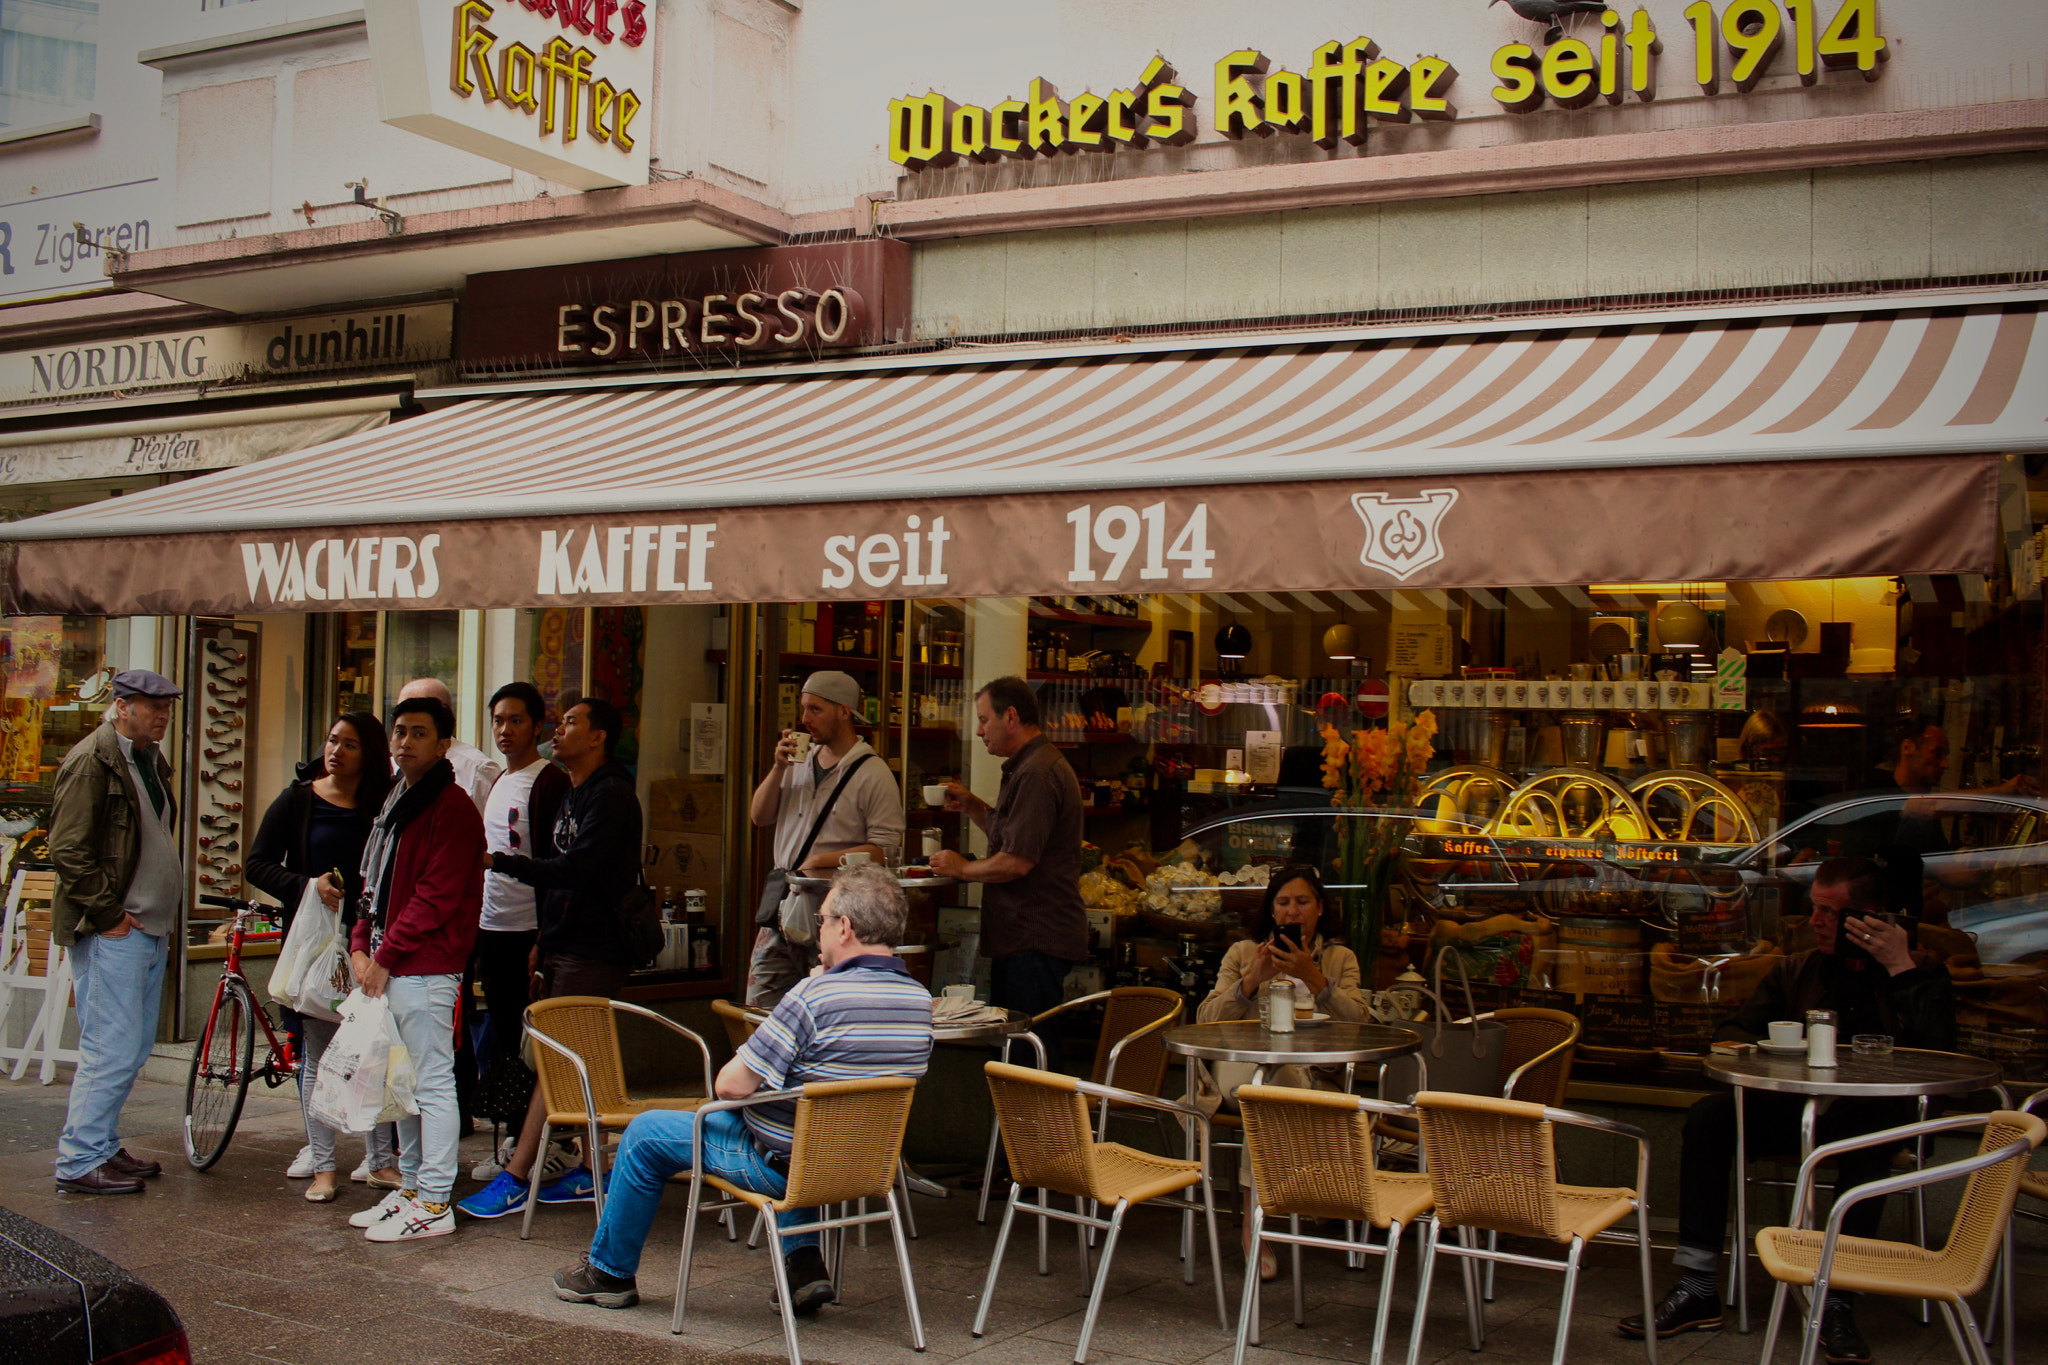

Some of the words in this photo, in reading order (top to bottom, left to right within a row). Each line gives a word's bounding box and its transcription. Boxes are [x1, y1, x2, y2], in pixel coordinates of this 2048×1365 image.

[450, 0, 642, 153] Kaffee
[887, 54, 1194, 170] Wacker's
[1214, 35, 1454, 146] Kaffee
[1490, 9, 1657, 106] seit
[1684, 0, 1888, 86] 1914
[267, 314, 405, 369] dunhill
[557, 289, 848, 356] ESPRESSO
[30, 335, 208, 394] NØRDING
[126, 432, 200, 472] Pfeifen
[240, 533, 441, 604] WACKERS
[537, 523, 718, 596] KAFFEE
[821, 514, 951, 589] seit
[1066, 501, 1215, 583] 1914
[1443, 839, 1492, 856] Kaffee
[1545, 845, 1605, 861] eigener
